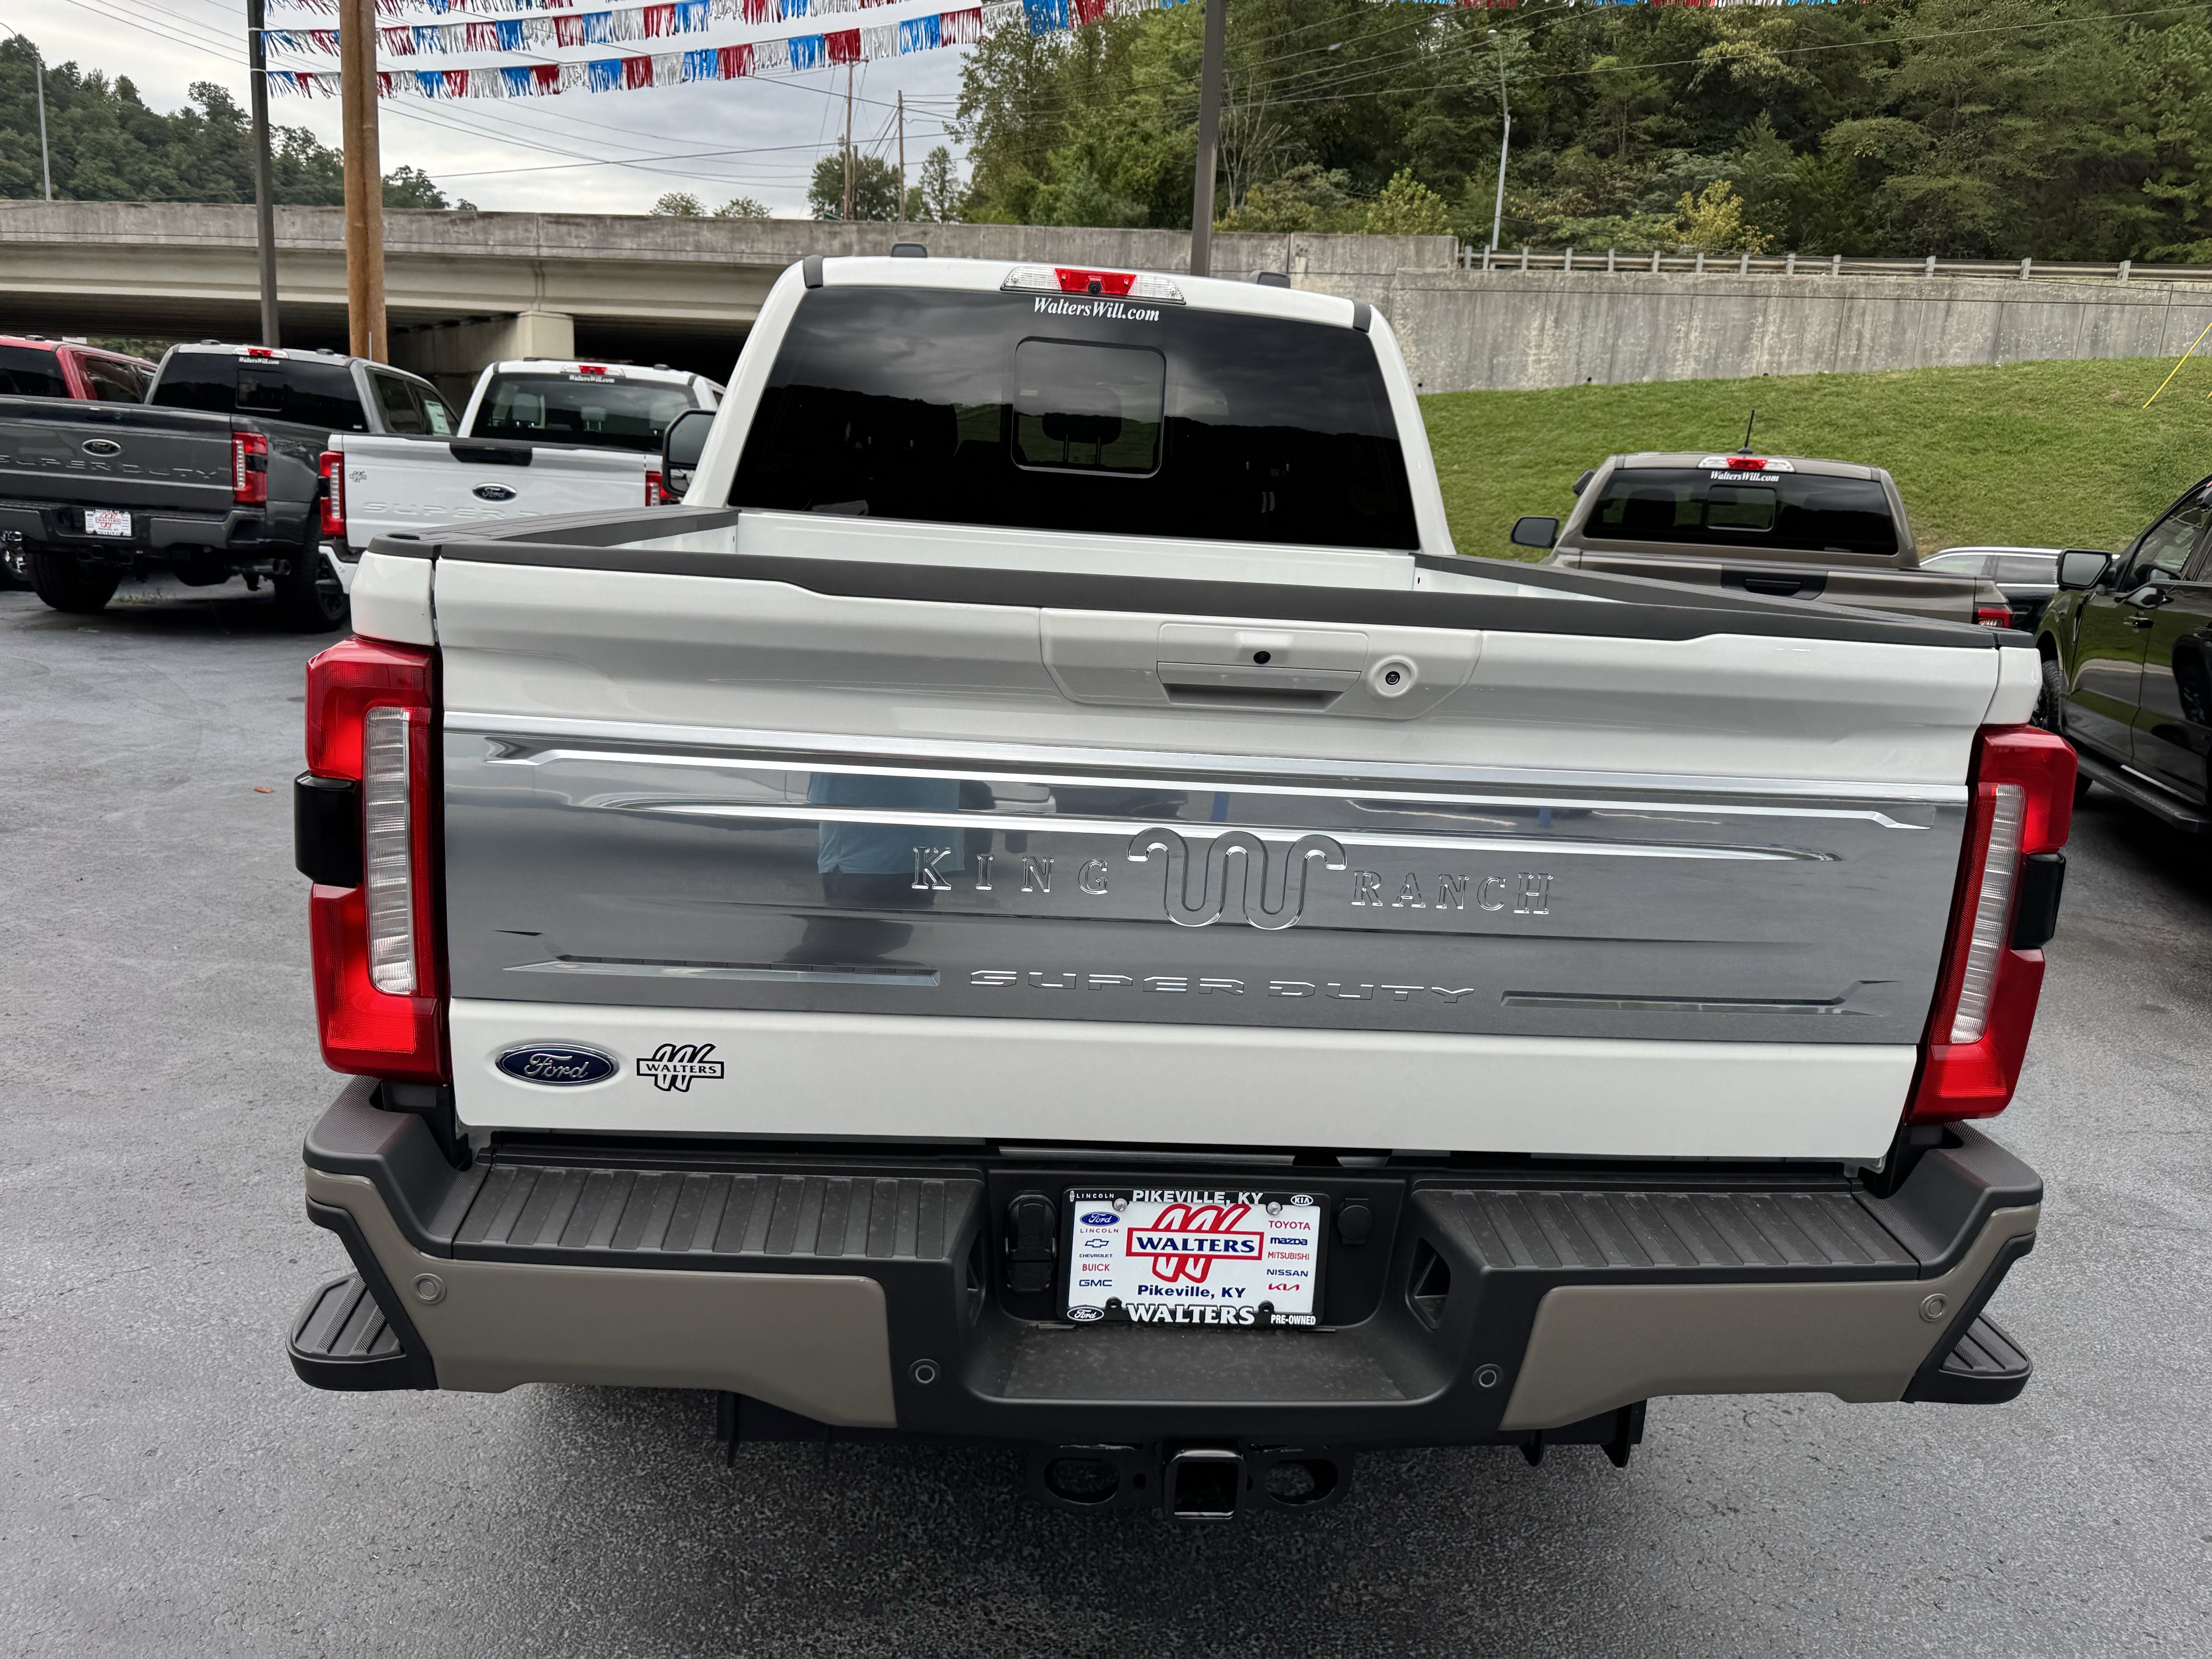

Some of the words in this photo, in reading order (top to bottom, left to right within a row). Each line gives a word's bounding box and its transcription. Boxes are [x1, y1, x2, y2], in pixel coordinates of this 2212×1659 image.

[1034, 297, 1160, 322] WaltersWill.com
[1710, 470, 1780, 482] WaltersWill.com
[911, 845, 1109, 895] KING
[1350, 870, 1554, 915] RANCH
[970, 969, 1245, 996] SUPER
[1267, 980, 1475, 1004] DUTY
[524, 1053, 590, 1080] Ford
[645, 1063, 717, 1075] WALTERS
[1132, 1190, 1230, 1206] PIKEVILLE,
[1238, 1192, 1264, 1205] KY
[1088, 1213, 1112, 1223] Ford
[1268, 1220, 1311, 1231] TOYOTA
[1135, 1237, 1255, 1253] WALTERS
[1267, 1251, 1310, 1261] MITSUBISHI
[1082, 1263, 1110, 1272] BUICK
[1266, 1269, 1309, 1277] NISSAN
[1138, 1284, 1215, 1299] Pikeville,
[1221, 1287, 1246, 1298] KY
[1074, 1309, 1097, 1319] Ford
[1127, 1304, 1255, 1325] WALTERS
[1270, 1314, 1317, 1325] PRE-OWNED
